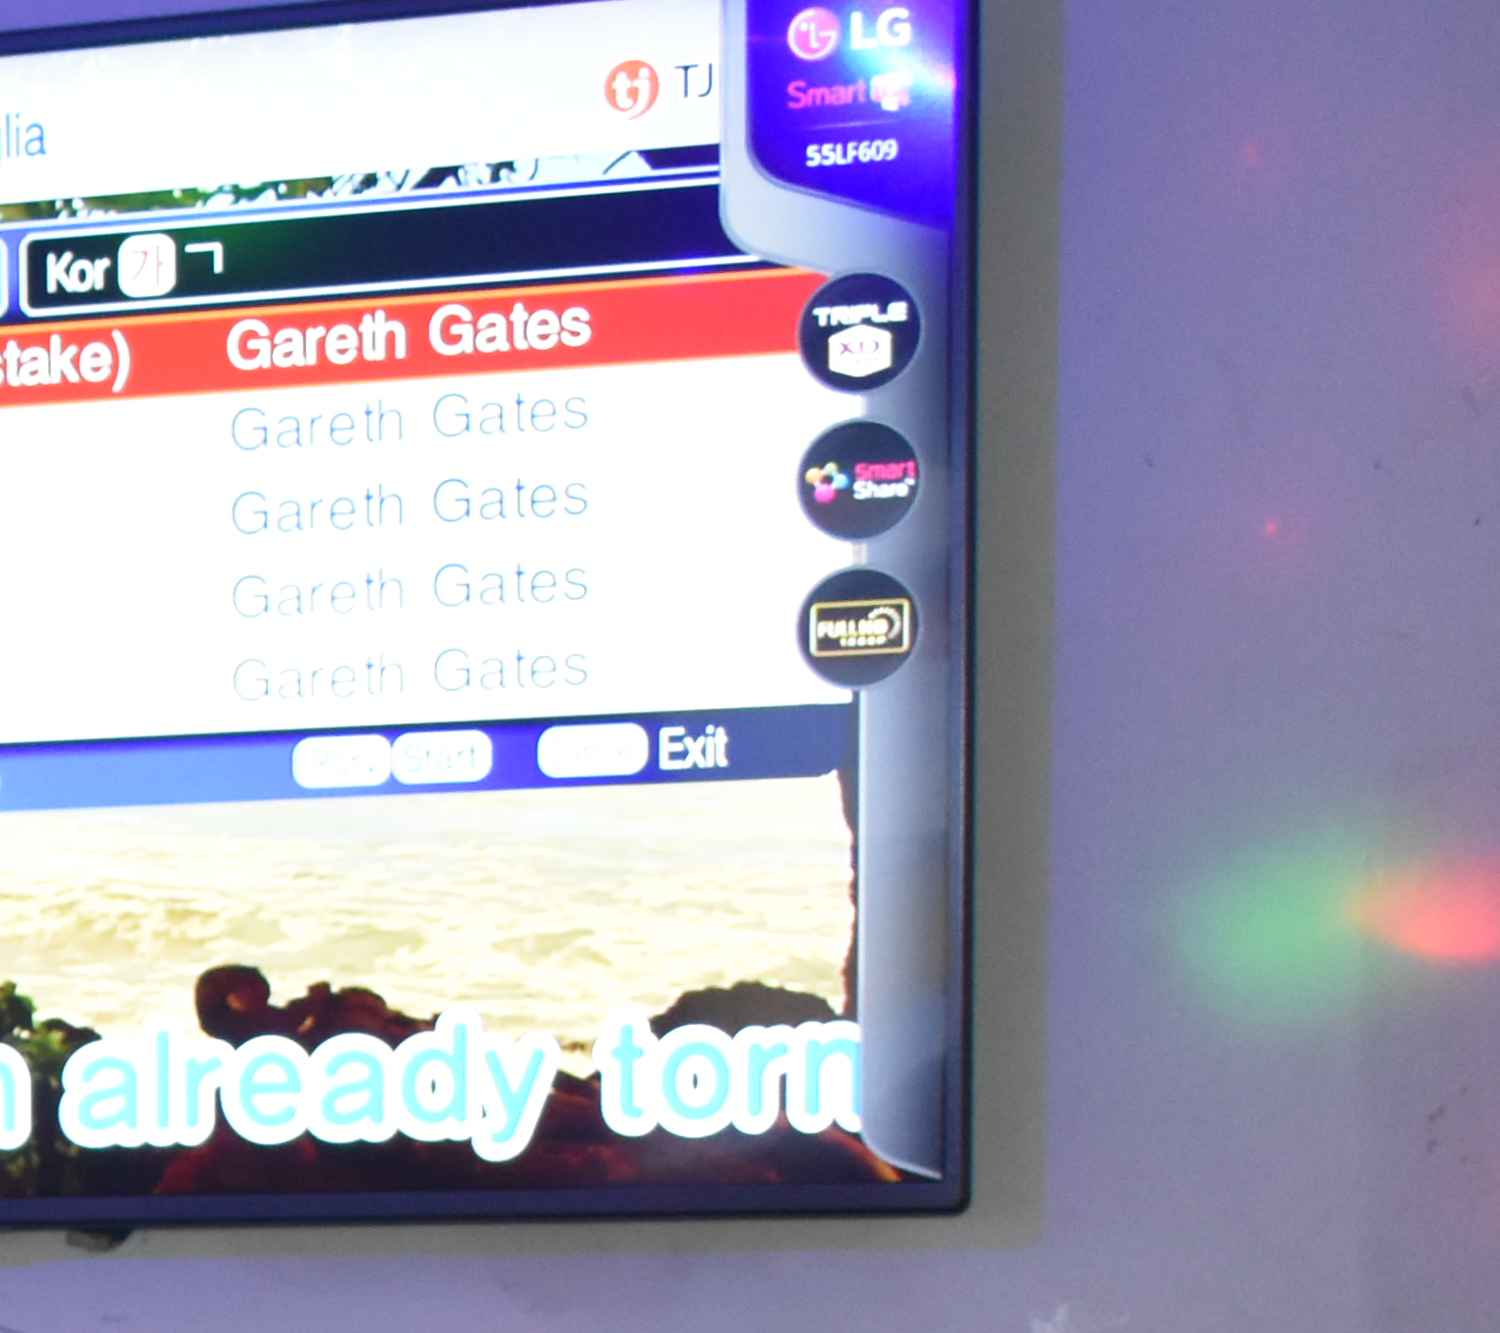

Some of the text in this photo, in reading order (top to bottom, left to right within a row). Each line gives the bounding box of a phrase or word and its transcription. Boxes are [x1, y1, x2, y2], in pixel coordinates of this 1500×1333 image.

[849, 8, 911, 50] LG
[675, 64, 715, 102] TJ
[787, 79, 867, 109] Smart
[45, 252, 109, 295] Kor
[226, 317, 407, 372] Gareth
[428, 300, 592, 358] Gates
[231, 402, 404, 451] Gareth
[432, 391, 588, 438] Gates
[854, 459, 917, 481] Smart
[231, 486, 404, 536] Gareth
[432, 476, 588, 523] Gates
[231, 569, 404, 620] Gareth
[432, 560, 588, 609] Gates
[232, 654, 404, 705] Gareth
[432, 645, 588, 694] Gates
[658, 726, 728, 771] Exit
[59, 1010, 559, 1164] already
[593, 1002, 862, 1138] torn
